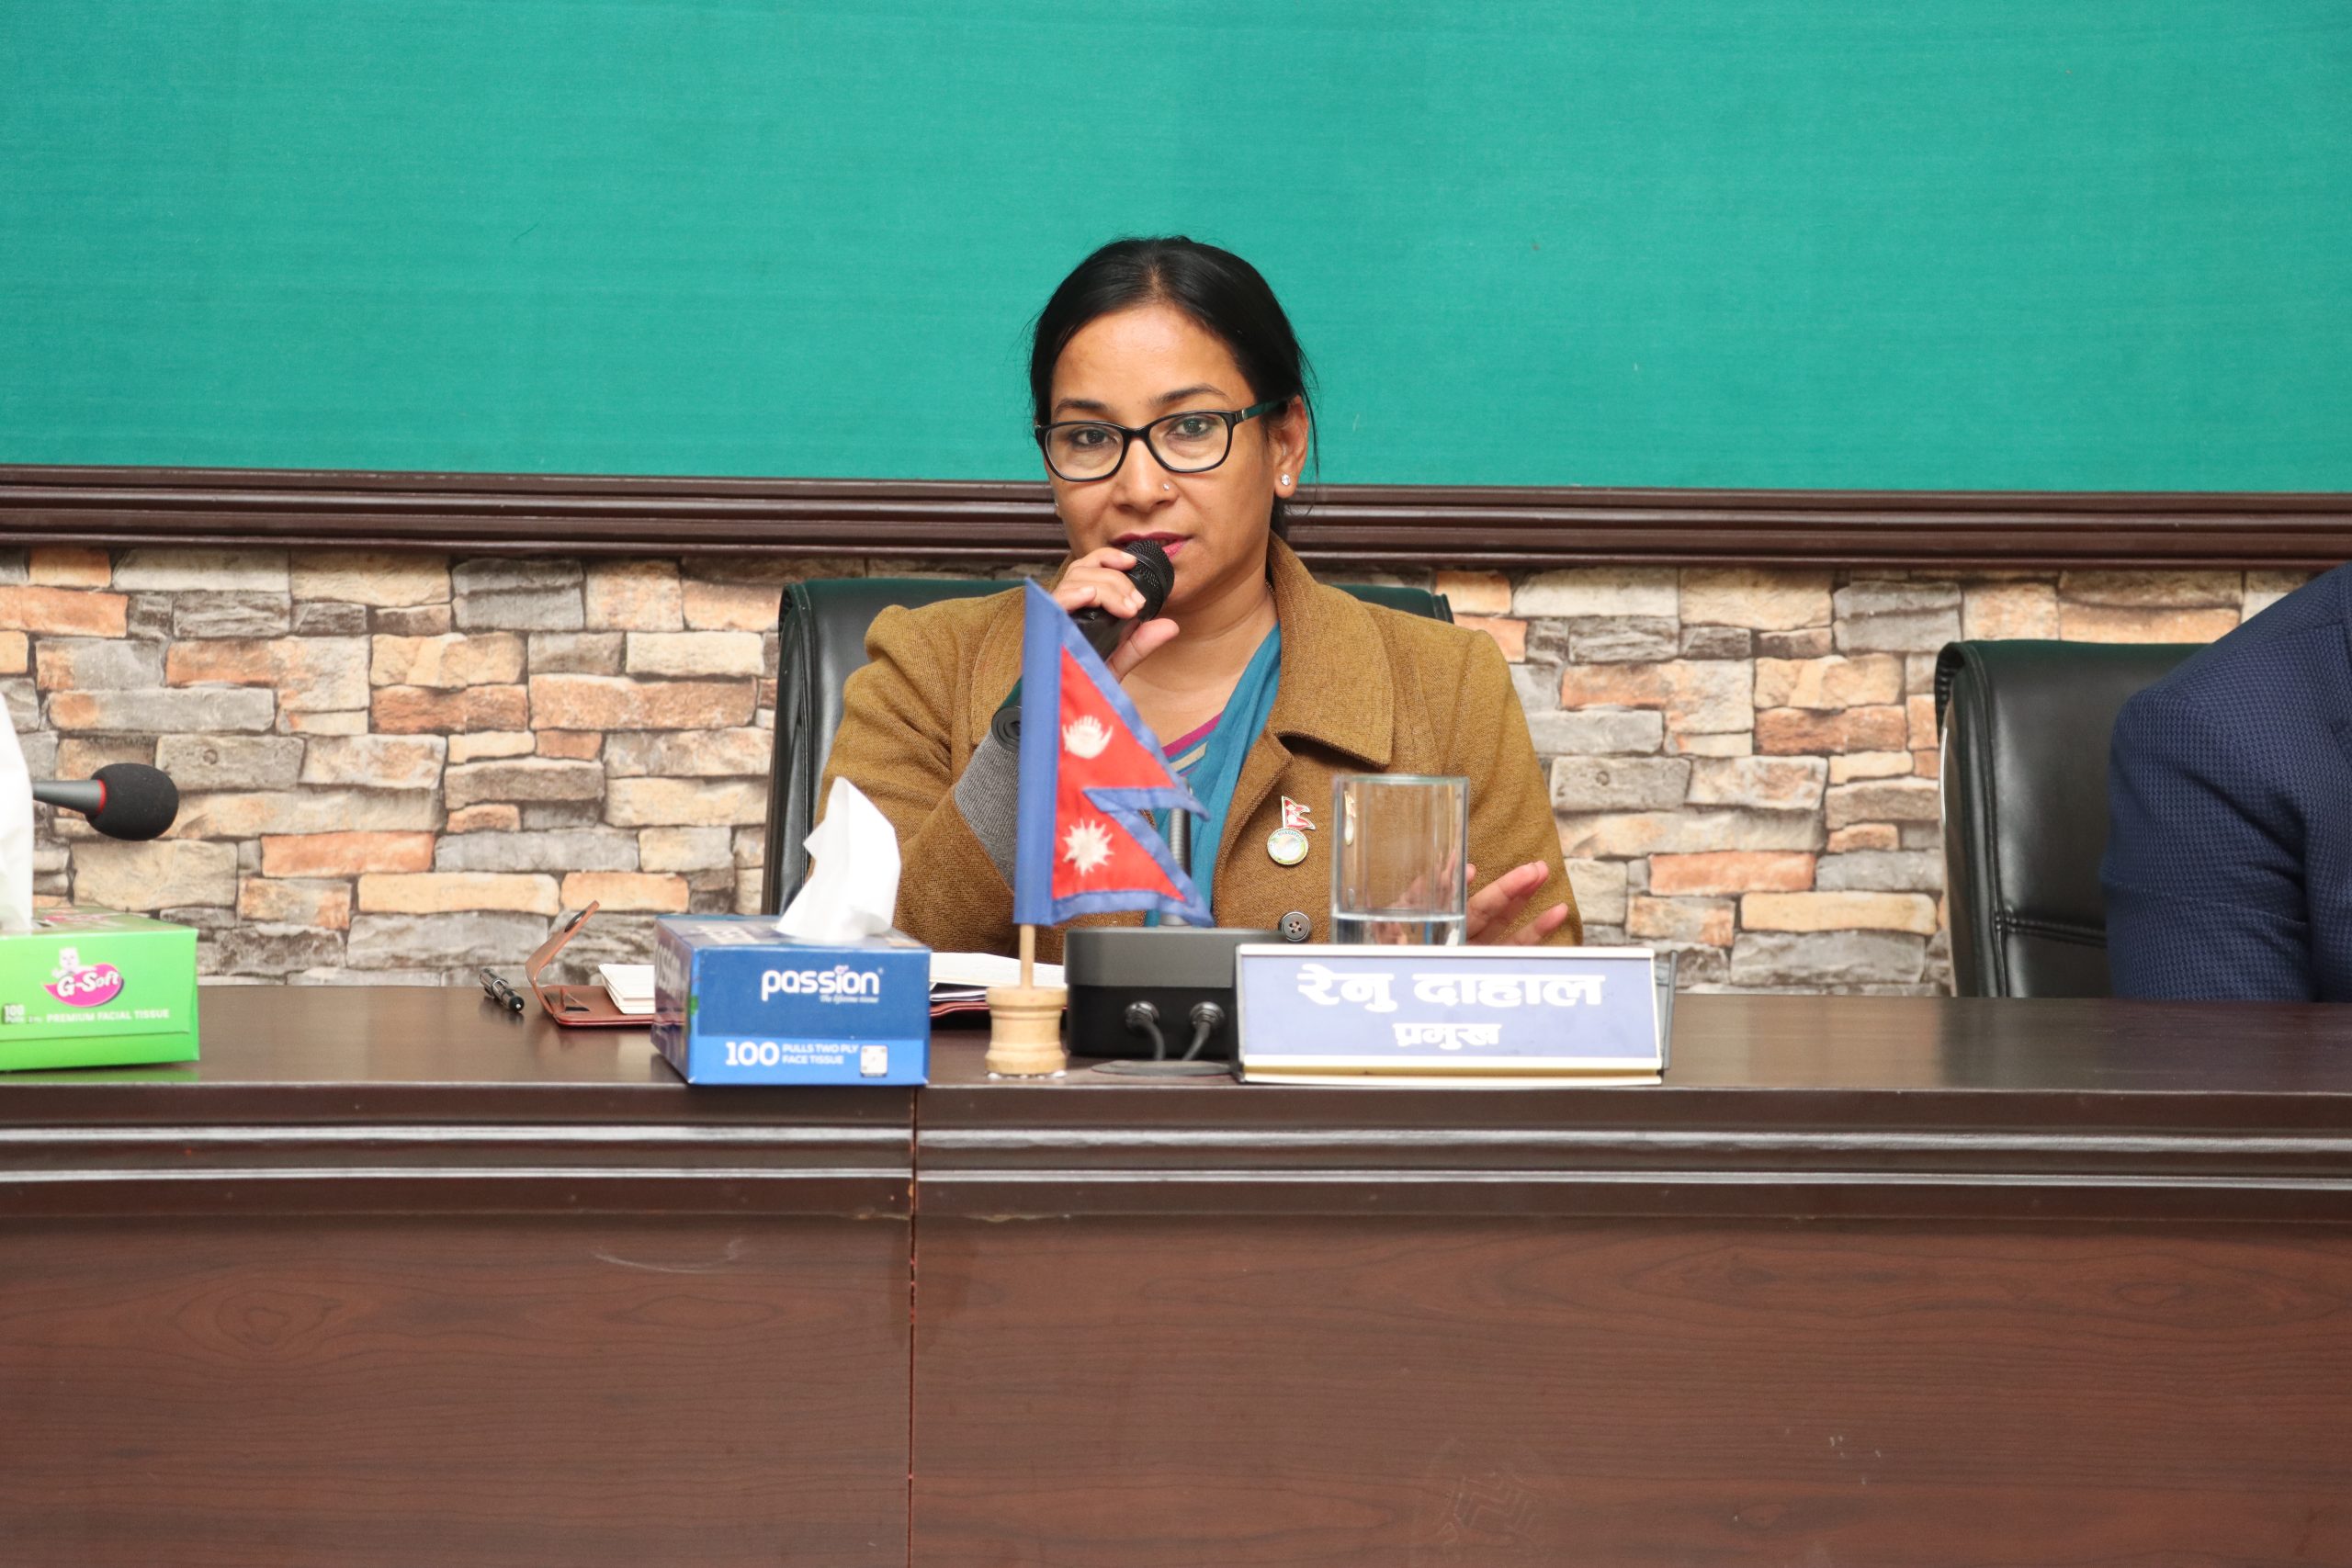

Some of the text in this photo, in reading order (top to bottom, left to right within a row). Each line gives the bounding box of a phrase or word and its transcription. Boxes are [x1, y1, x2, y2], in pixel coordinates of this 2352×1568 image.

[56, 970, 119, 997] G-Soft
[761, 964, 880, 1002] passion
[1296, 964, 1606, 1012] रेनु दाहाल
[46, 1011, 95, 1023] PREMIUM
[96, 1010, 131, 1021] FACIAL
[133, 1009, 170, 1020] TISSUE
[781, 1043, 860, 1054] PULLS TWO PLY
[1392, 1022, 1501, 1050] प्रमुख
[725, 1041, 780, 1066] 100
[781, 1055, 844, 1065] FACE TISSUE
